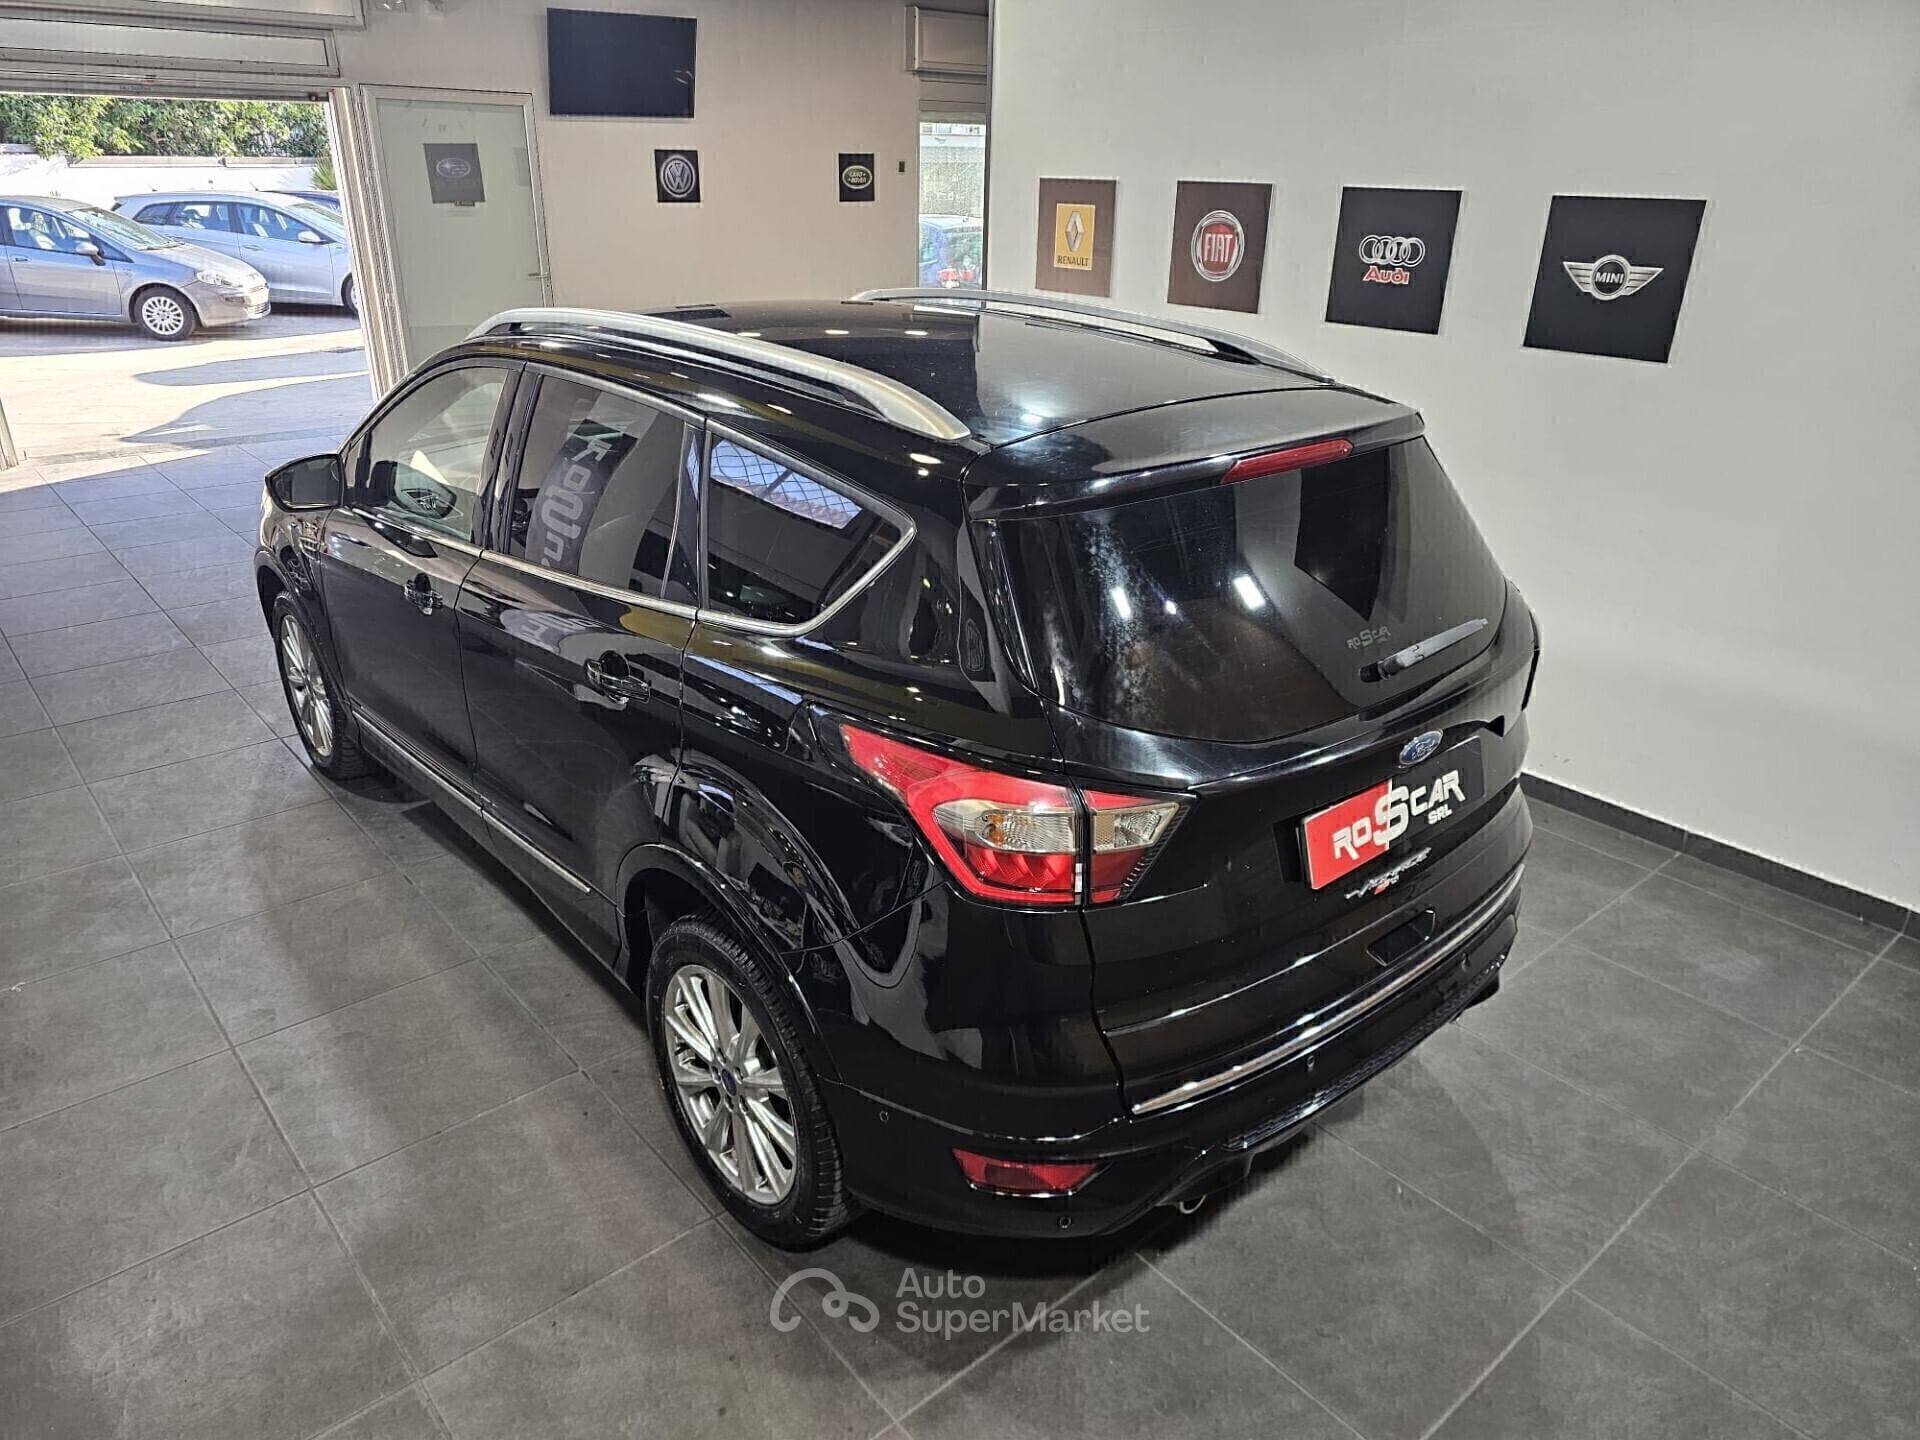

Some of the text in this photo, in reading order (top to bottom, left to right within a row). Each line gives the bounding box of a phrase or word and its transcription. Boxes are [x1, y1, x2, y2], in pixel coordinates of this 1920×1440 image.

[1203, 233, 1233, 263] FIAT
[1057, 255, 1089, 267] RENAULT
[1362, 265, 1410, 285] Audi
[1595, 271, 1625, 284] MINI
[1427, 803, 1453, 825] SRL
